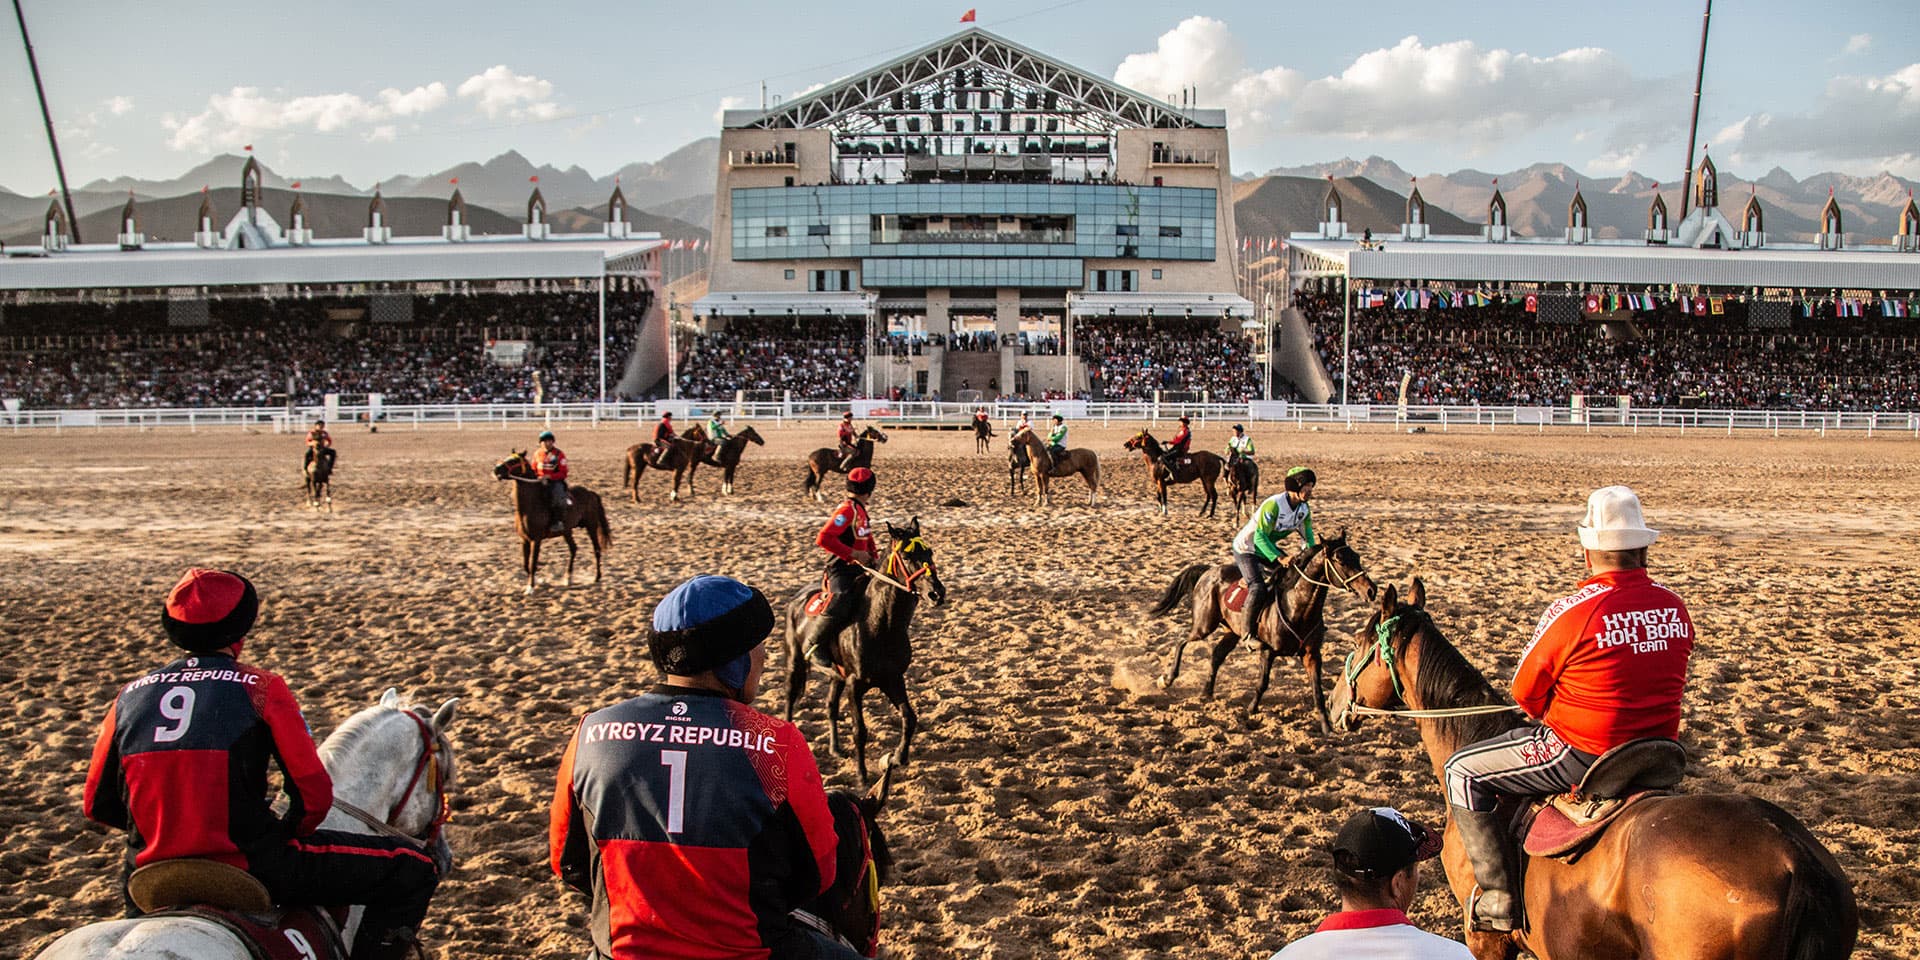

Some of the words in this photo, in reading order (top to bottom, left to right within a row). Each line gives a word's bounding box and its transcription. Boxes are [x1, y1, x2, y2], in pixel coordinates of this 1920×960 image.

[1602, 608, 1680, 630] KYRGYZ
[1595, 627, 1639, 649] KOK
[1645, 622, 1689, 641] BORU
[1630, 639, 1668, 654] TEAM
[126, 672, 178, 693] KYRGYZ
[182, 670, 260, 685] REPUBLIC
[154, 686, 196, 743] 9
[585, 722, 667, 744] KYRGYZ
[669, 726, 776, 754] REPUBLIC
[661, 749, 688, 833] 1
